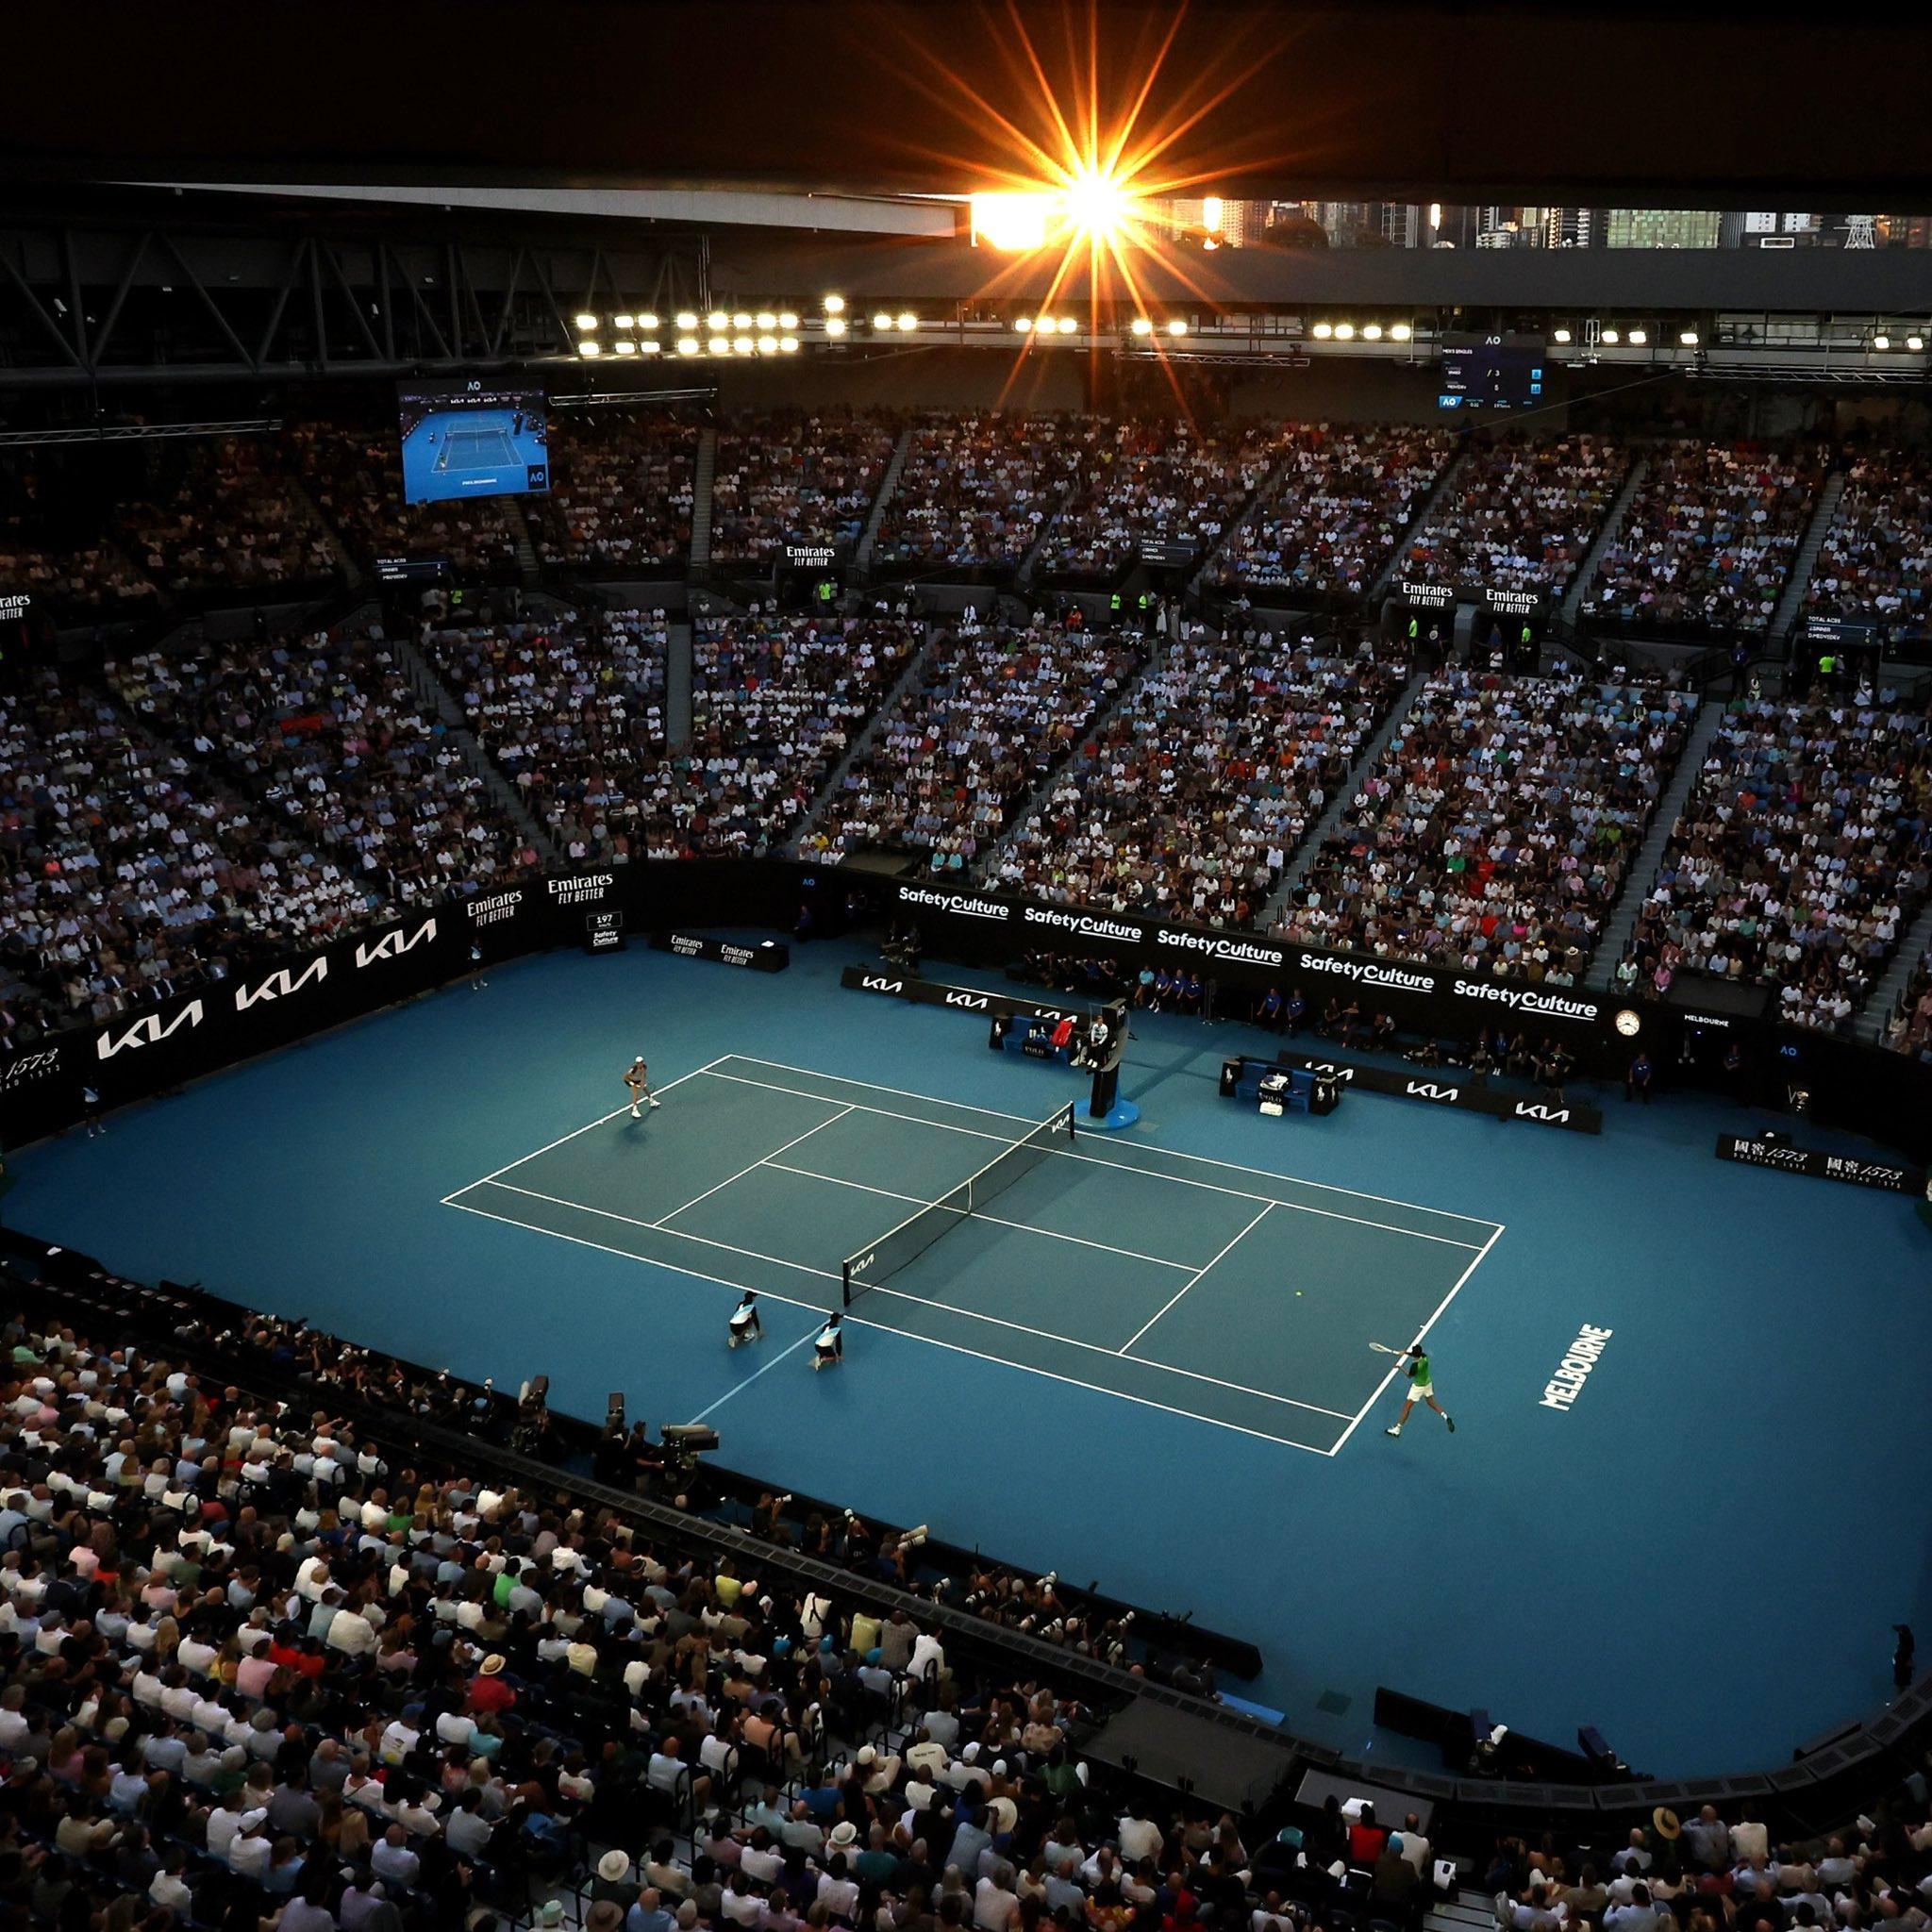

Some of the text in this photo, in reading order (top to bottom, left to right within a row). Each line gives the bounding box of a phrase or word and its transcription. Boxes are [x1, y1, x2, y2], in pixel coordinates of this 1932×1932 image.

[786, 546, 835, 557] Emirates
[794, 558, 828, 566] FLY BETTER
[1403, 582, 1453, 597] Emirates
[1486, 589, 1539, 604] Emirates
[1409, 594, 1445, 607] FLY BETTER
[1493, 602, 1530, 613] FLY BETTER
[548, 874, 613, 893] Emirates
[467, 891, 523, 917] Emirates
[558, 888, 604, 905] FLY BETTER
[898, 887, 1009, 919] SafetyCulture
[476, 906, 515, 927] FLY BETTER
[597, 914, 613, 924] 197
[1024, 908, 1142, 941] SafetyCulture
[356, 918, 437, 968] KIA
[671, 935, 703, 949] Emirates
[1158, 929, 1283, 965] SafetyCulture
[721, 944, 754, 959] Emirates
[1300, 954, 1435, 991] SafetyCulture
[236, 957, 328, 1011] KIA
[862, 975, 903, 992] KIA
[946, 991, 989, 1009] KIA
[1453, 980, 1598, 1019] SafetyCulture
[97, 999, 204, 1059] KIA
[1684, 1014, 1729, 1027] MELBOURNE
[6, 1047, 58, 1080] 1573
[1407, 1081, 1458, 1102] KIA
[1515, 1101, 1570, 1123] KIA
[1766, 1148, 1808, 1162] 1573
[1860, 1166, 1904, 1180] 1573
[1539, 1324, 1613, 1411] MELBOURNE
